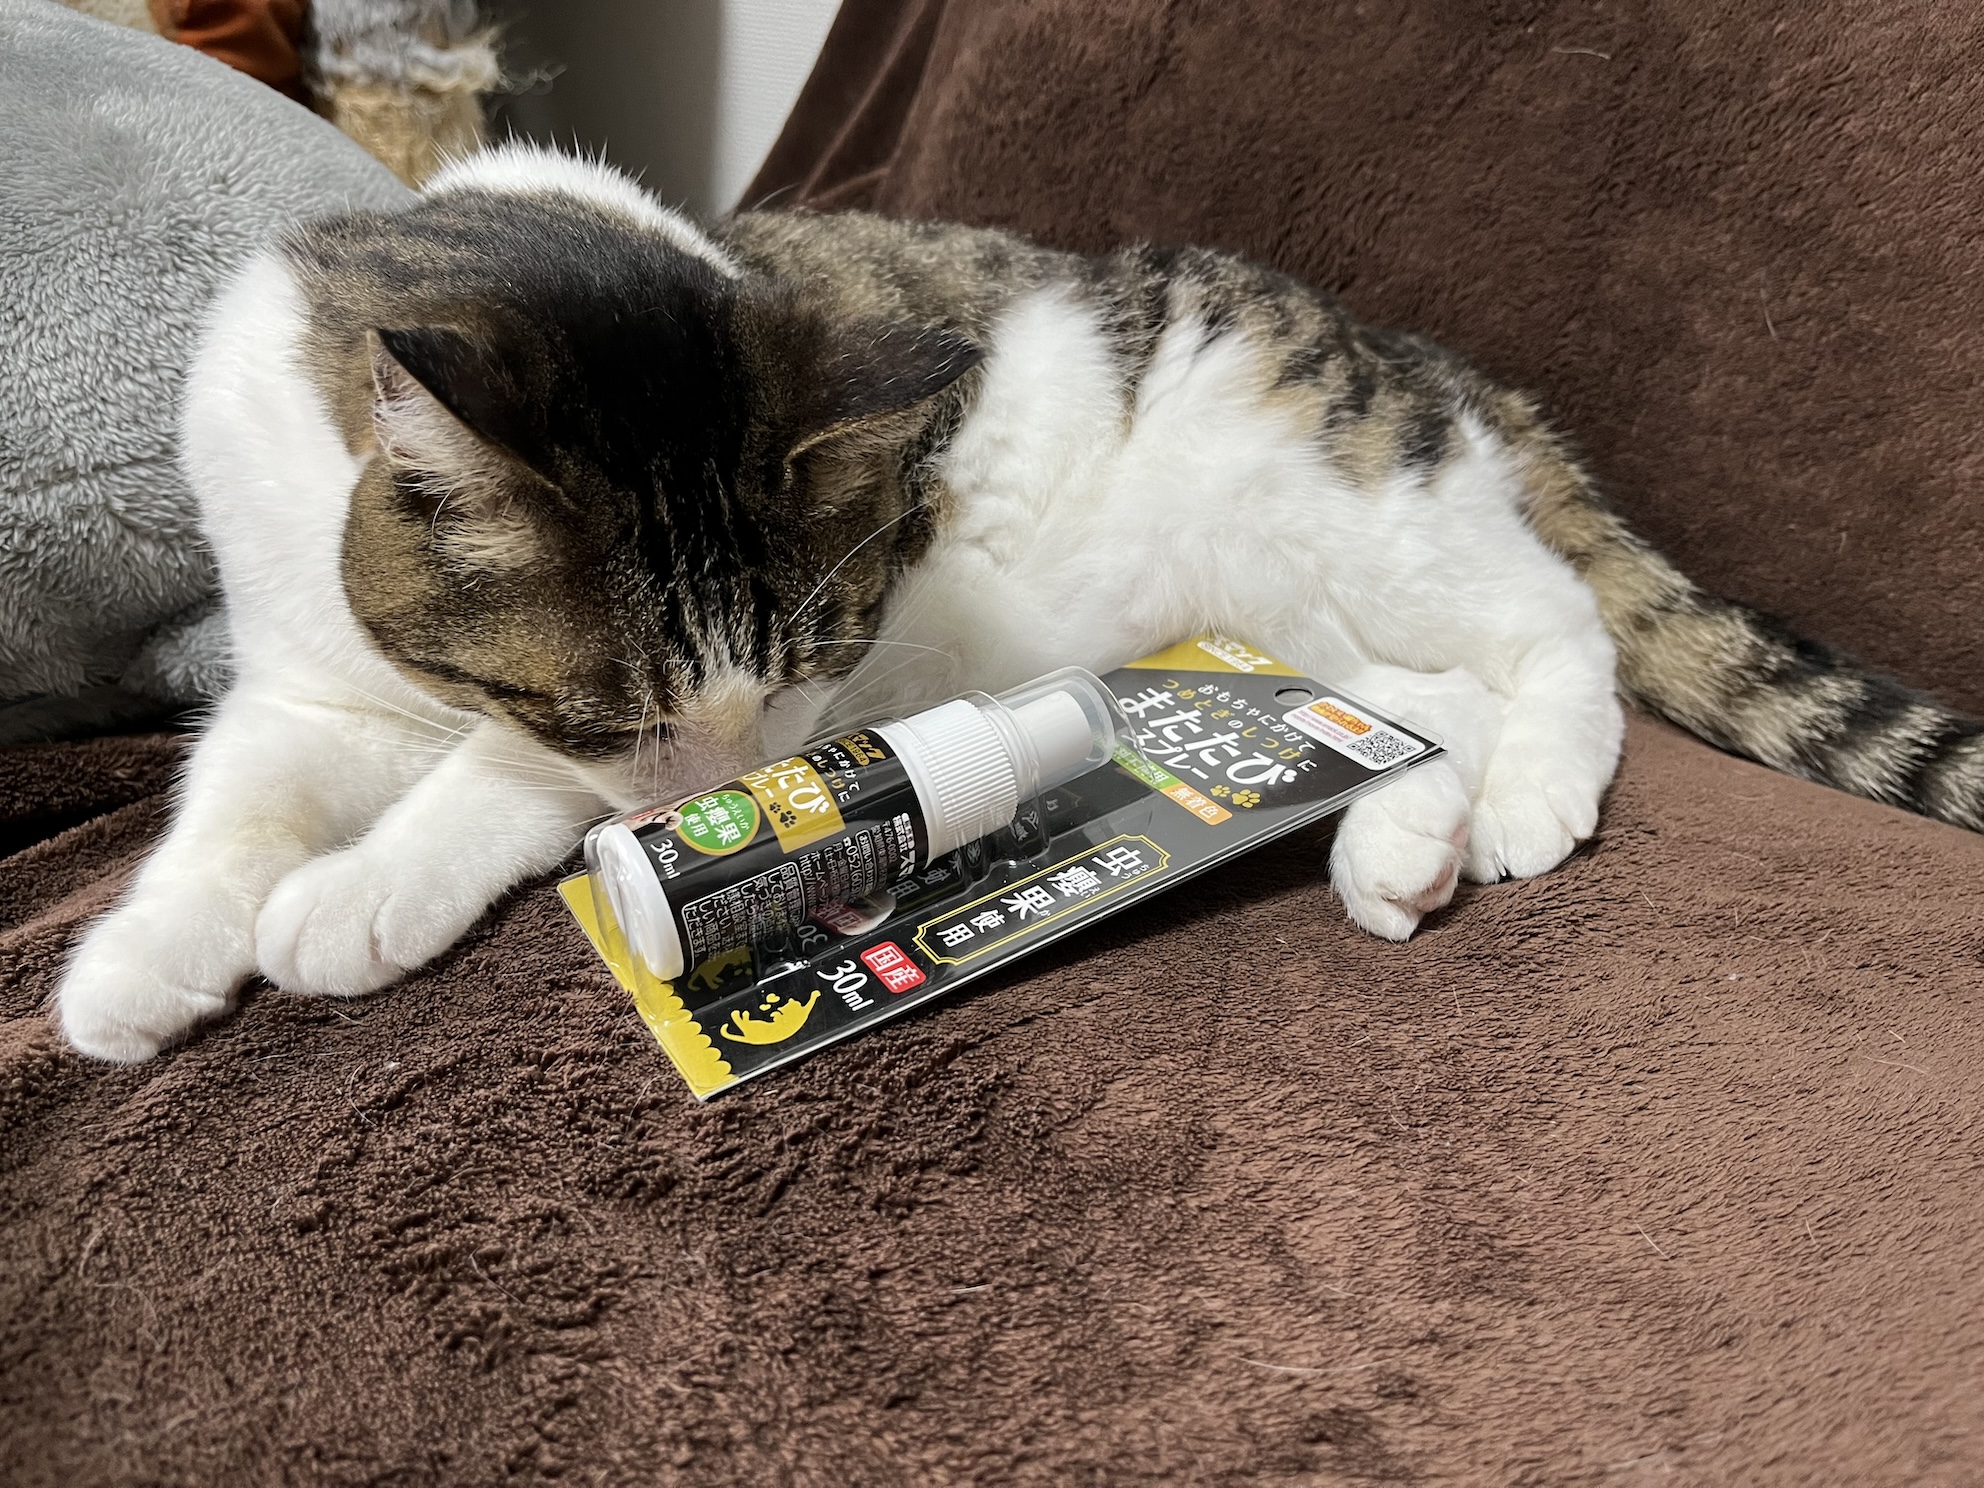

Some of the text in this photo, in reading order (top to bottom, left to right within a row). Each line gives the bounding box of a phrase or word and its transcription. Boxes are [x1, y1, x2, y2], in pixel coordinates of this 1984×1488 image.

[1118, 687, 1297, 785] またたび
[1162, 679, 1317, 772] つめとぎのしつけに
[1198, 684, 1315, 752] おもちゃにかけて
[846, 732, 886, 759] マック
[1121, 727, 1209, 780] スプレー
[684, 812, 709, 838] 使用
[1170, 787, 1219, 820] 無着色
[650, 838, 681, 880] 30ml
[816, 959, 875, 1012] 30ml
[865, 945, 921, 991] 国産
